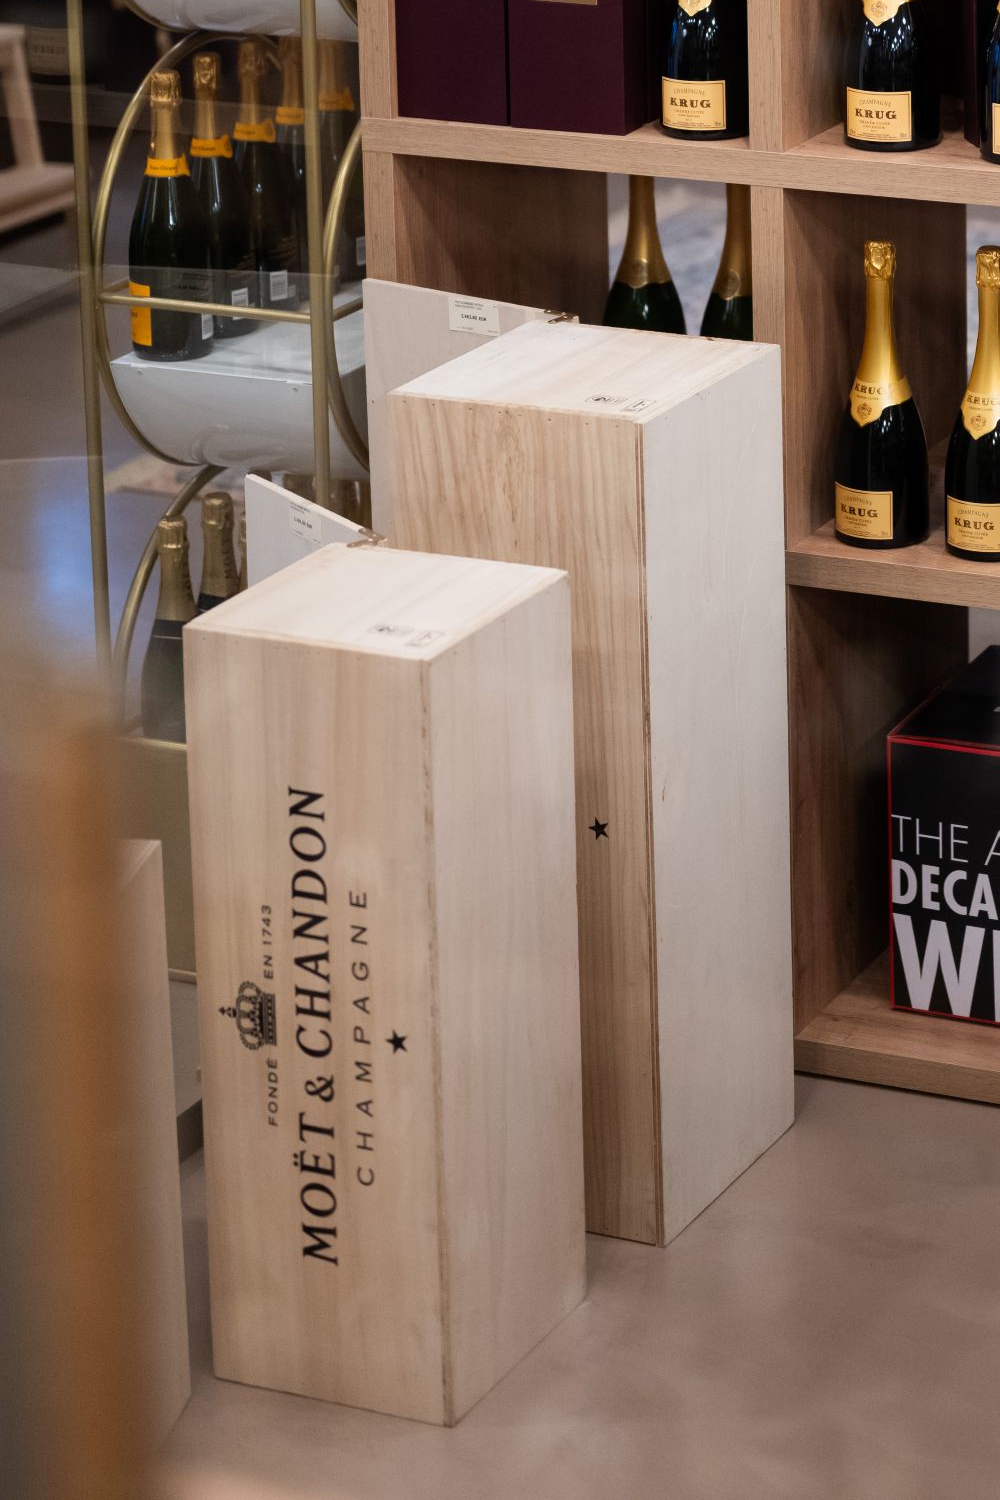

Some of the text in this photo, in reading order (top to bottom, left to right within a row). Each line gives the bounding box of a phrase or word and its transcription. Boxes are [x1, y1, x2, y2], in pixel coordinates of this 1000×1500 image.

[669, 97, 712, 109] KRUG
[855, 108, 898, 120] KRUG
[840, 503, 878, 518] KRUG
[954, 517, 995, 531] KRUG
[890, 814, 969, 863] THE
[261, 905, 279, 1127] FONDÉ EN 1743
[288, 787, 339, 1266] MOËT & CHANDON
[350, 890, 375, 1186] CHAMPAGNE
